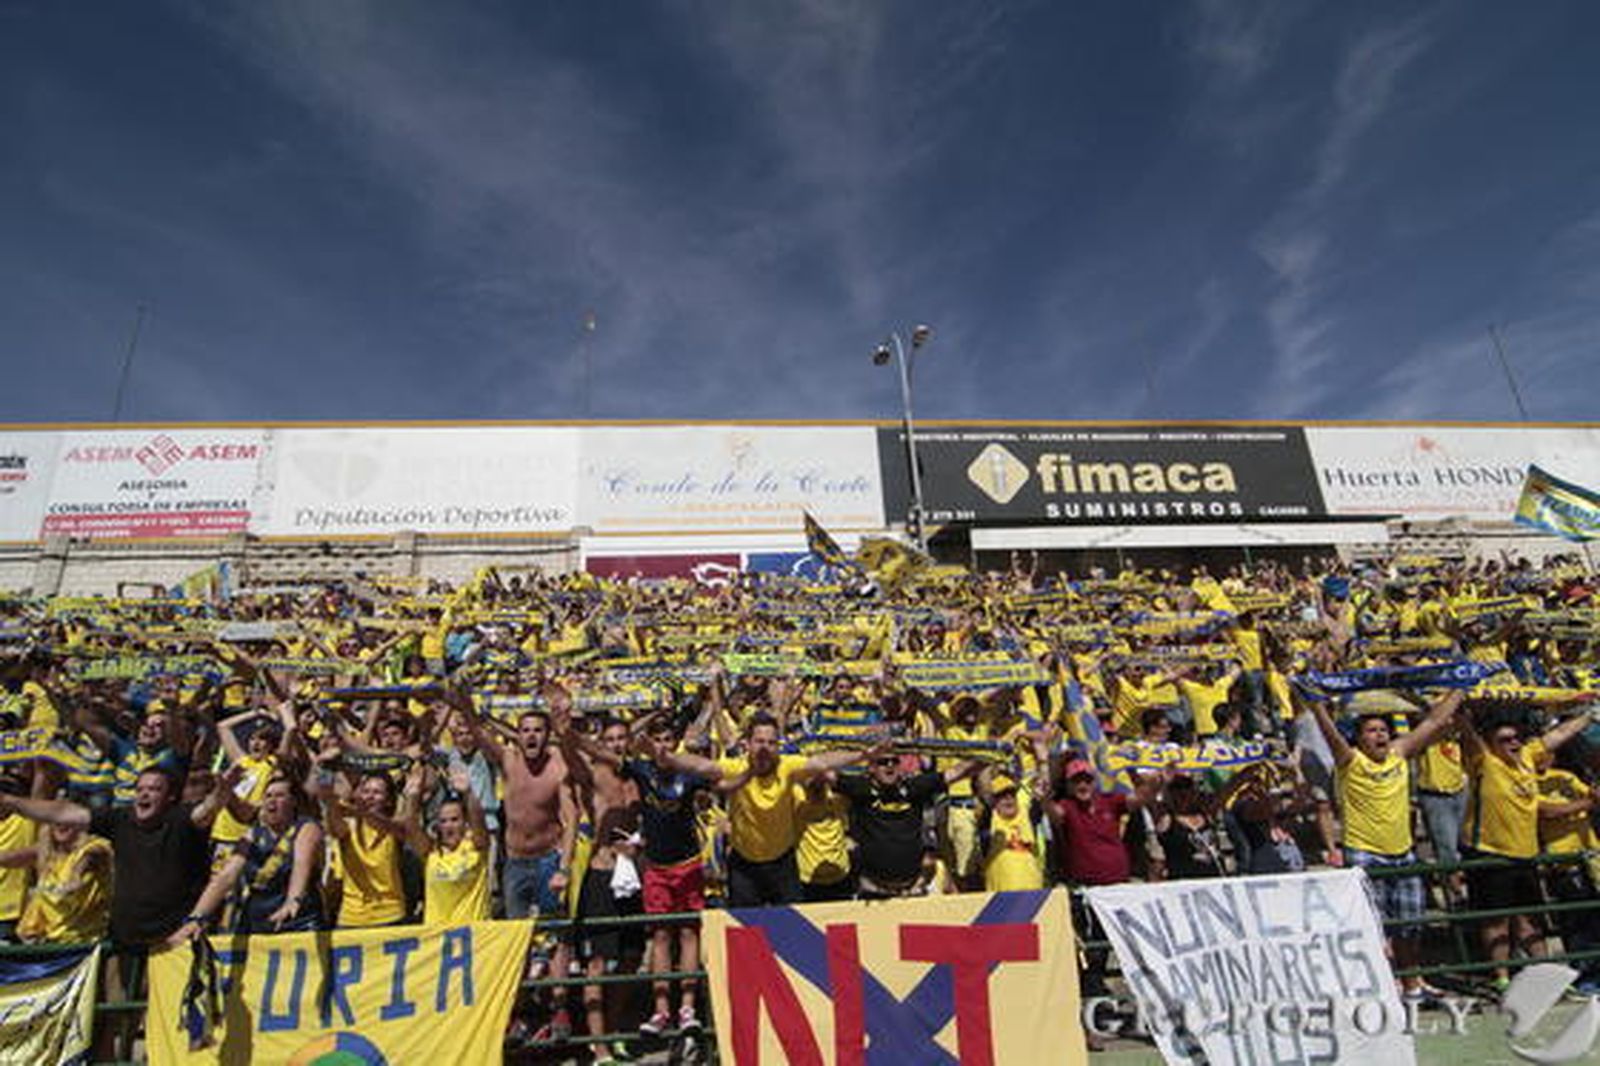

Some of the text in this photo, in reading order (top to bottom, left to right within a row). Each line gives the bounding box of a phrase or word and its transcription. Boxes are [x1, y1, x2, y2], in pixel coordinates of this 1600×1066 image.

[65, 447, 132, 463] ASEM
[190, 445, 258, 460] ASEM
[600, 470, 697, 495] Conde
[711, 471, 737, 494] de
[754, 471, 779, 494] la
[1036, 453, 1236, 494] fimaca
[1324, 467, 1526, 487] Huerta HOND
[443, 503, 564, 527] Deportiva
[1046, 501, 1244, 519] SUMINISTROS
[1114, 878, 1346, 960] NUNCA
